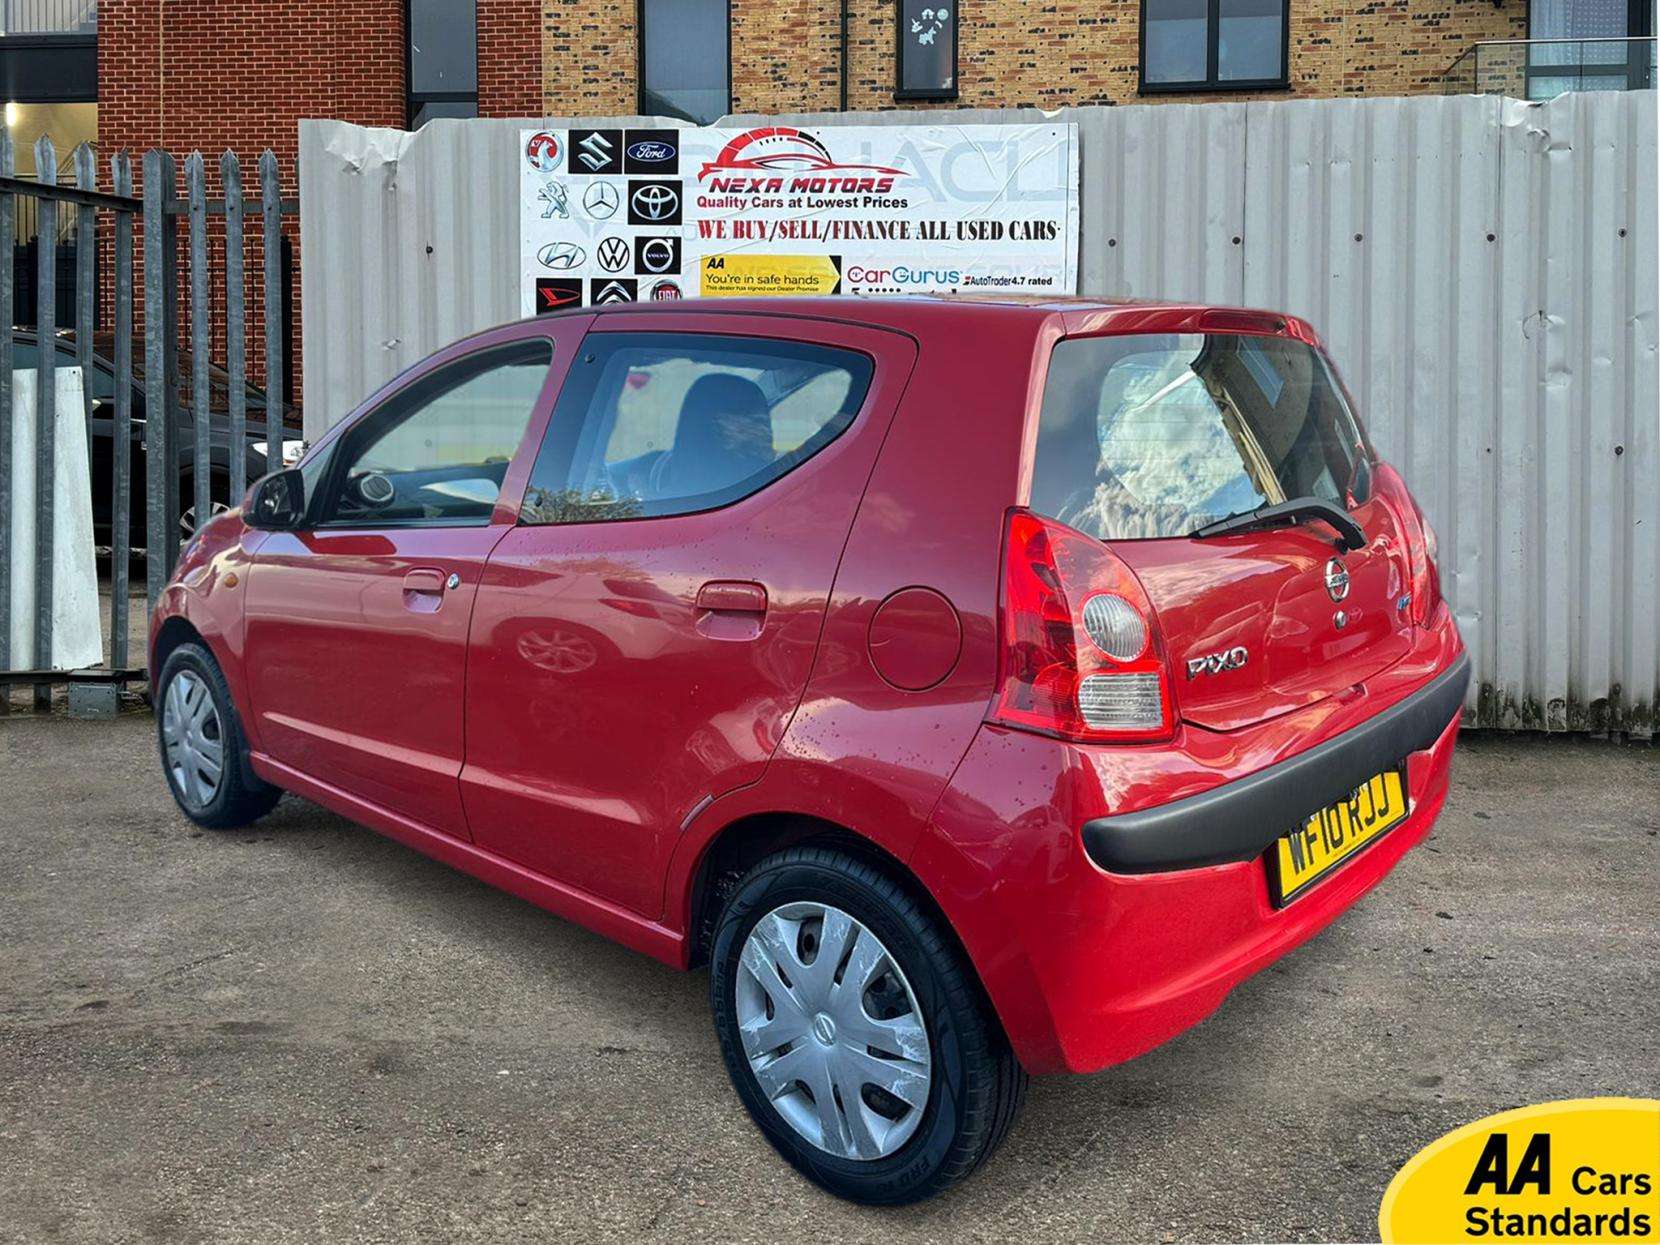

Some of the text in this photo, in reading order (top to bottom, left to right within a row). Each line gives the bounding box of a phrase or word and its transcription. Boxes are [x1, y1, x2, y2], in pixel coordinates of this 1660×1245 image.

[636, 144, 666, 159] Ford
[709, 177, 895, 194] NEXA MOTORS
[697, 196, 909, 210] Quality Cars at Lowest Prices
[697, 220, 727, 240] WE
[916, 220, 951, 240] ALL
[956, 220, 1004, 241] USED
[706, 257, 725, 270] AA
[705, 273, 820, 286] You're in safe hands
[847, 266, 960, 283] CarGurus
[1028, 277, 1053, 286] rated
[1186, 646, 1249, 681] PIXO
